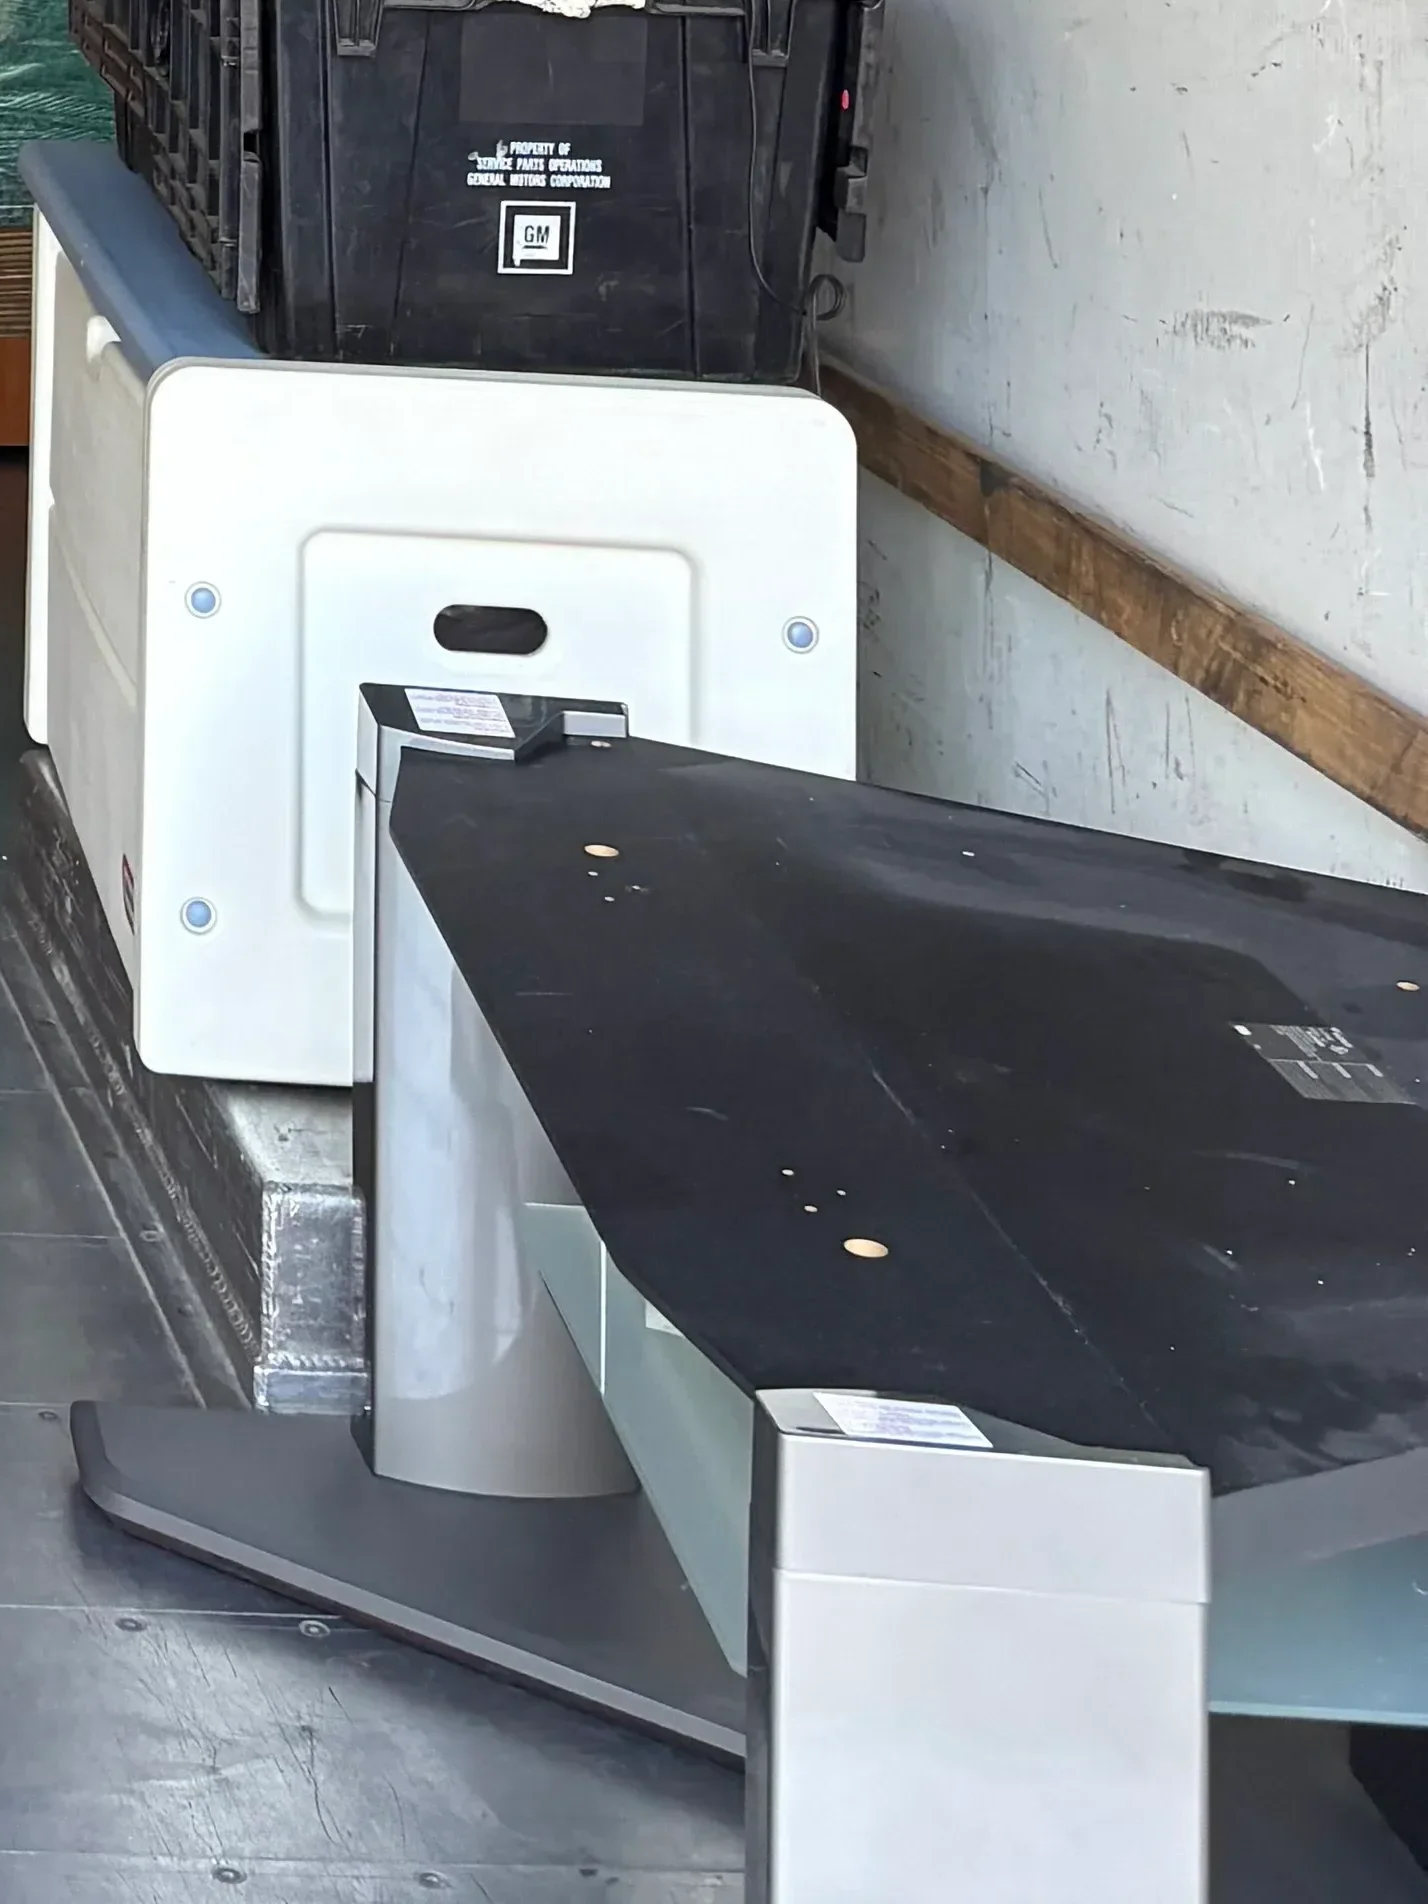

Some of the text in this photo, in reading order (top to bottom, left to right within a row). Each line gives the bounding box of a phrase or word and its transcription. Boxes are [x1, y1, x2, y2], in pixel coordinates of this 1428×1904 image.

[510, 141, 571, 155] PROPERTY OF
[476, 157, 603, 173] SERVICE PARTS OPERATIONS
[467, 172, 612, 189] GENERAL MOTORS CORPORATION
[524, 224, 550, 244] GM
